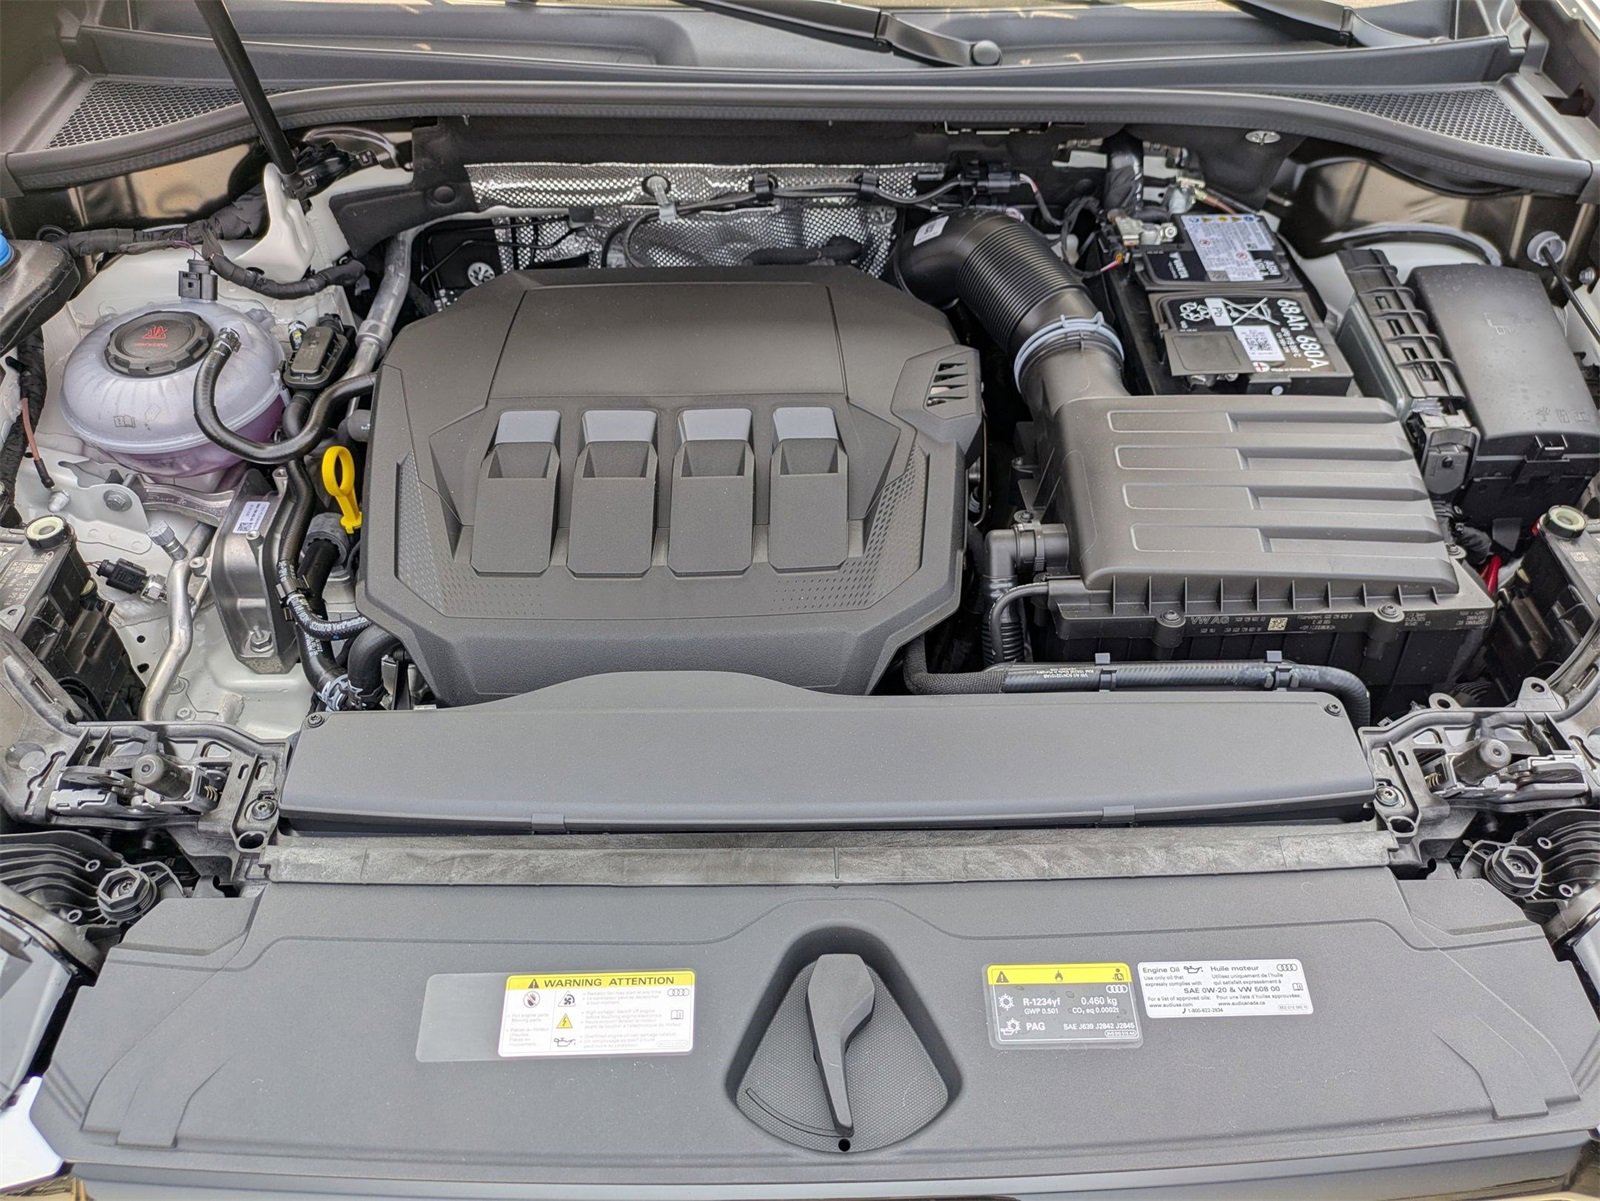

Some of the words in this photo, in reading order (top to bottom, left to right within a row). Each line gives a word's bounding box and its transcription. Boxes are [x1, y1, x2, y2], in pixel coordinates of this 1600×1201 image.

[1212, 306, 1223, 318] Pb
[1276, 298, 1308, 332] 68Ah
[1296, 334, 1329, 369] 680A
[1190, 616, 1210, 625] VW
[1211, 616, 1230, 624] AG
[544, 978, 602, 988] WARNING
[608, 976, 675, 986] ATTENTION
[1023, 998, 1060, 1006] R-1234yf
[1081, 997, 1105, 1005] 0.460
[1106, 996, 1118, 1006] kg
[1026, 1022, 1046, 1031] PAG
